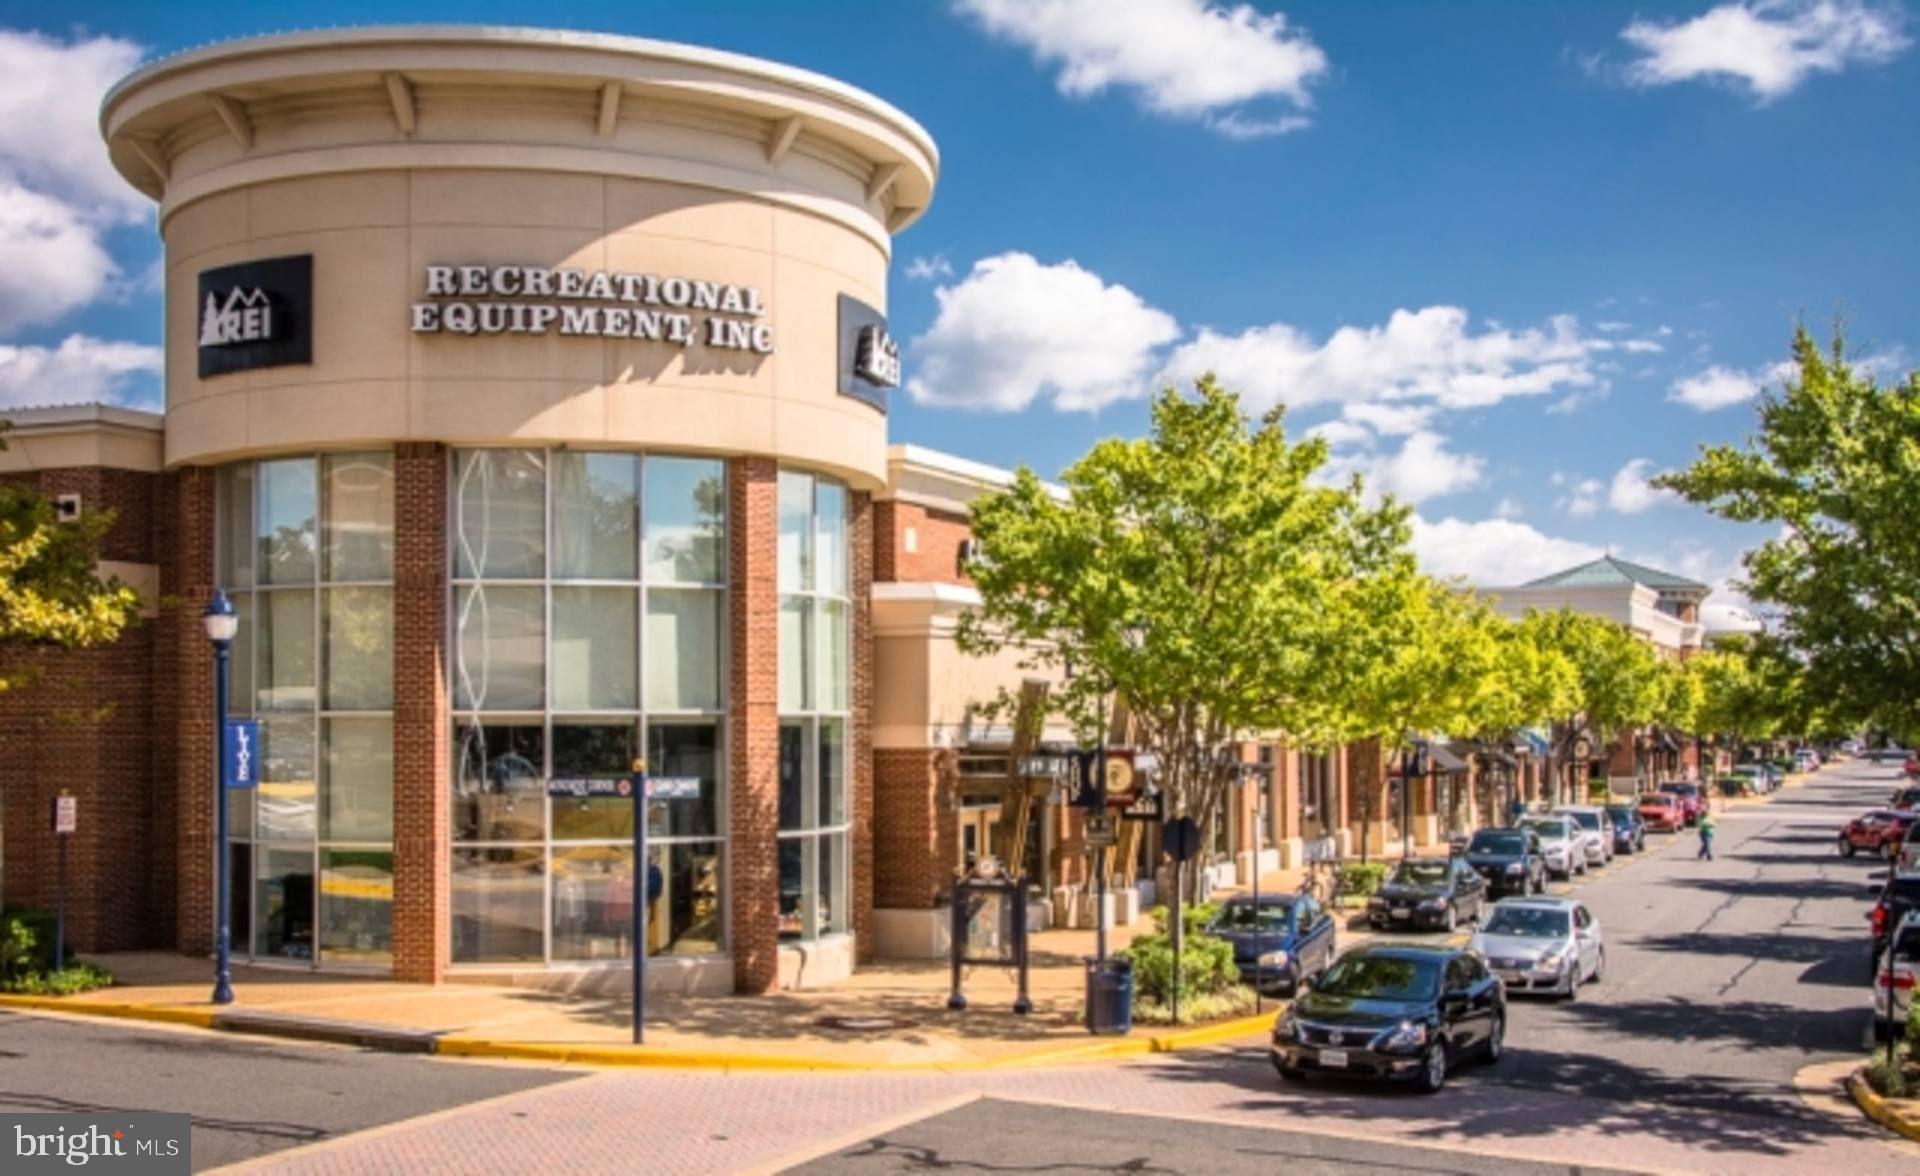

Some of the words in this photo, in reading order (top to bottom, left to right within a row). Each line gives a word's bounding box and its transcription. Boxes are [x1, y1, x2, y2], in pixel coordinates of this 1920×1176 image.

[426, 265, 766, 316] RECREATIONAL
[222, 299, 271, 341] REI
[411, 302, 697, 346] EQUIPMENT,
[237, 726, 250, 780] LIVE
